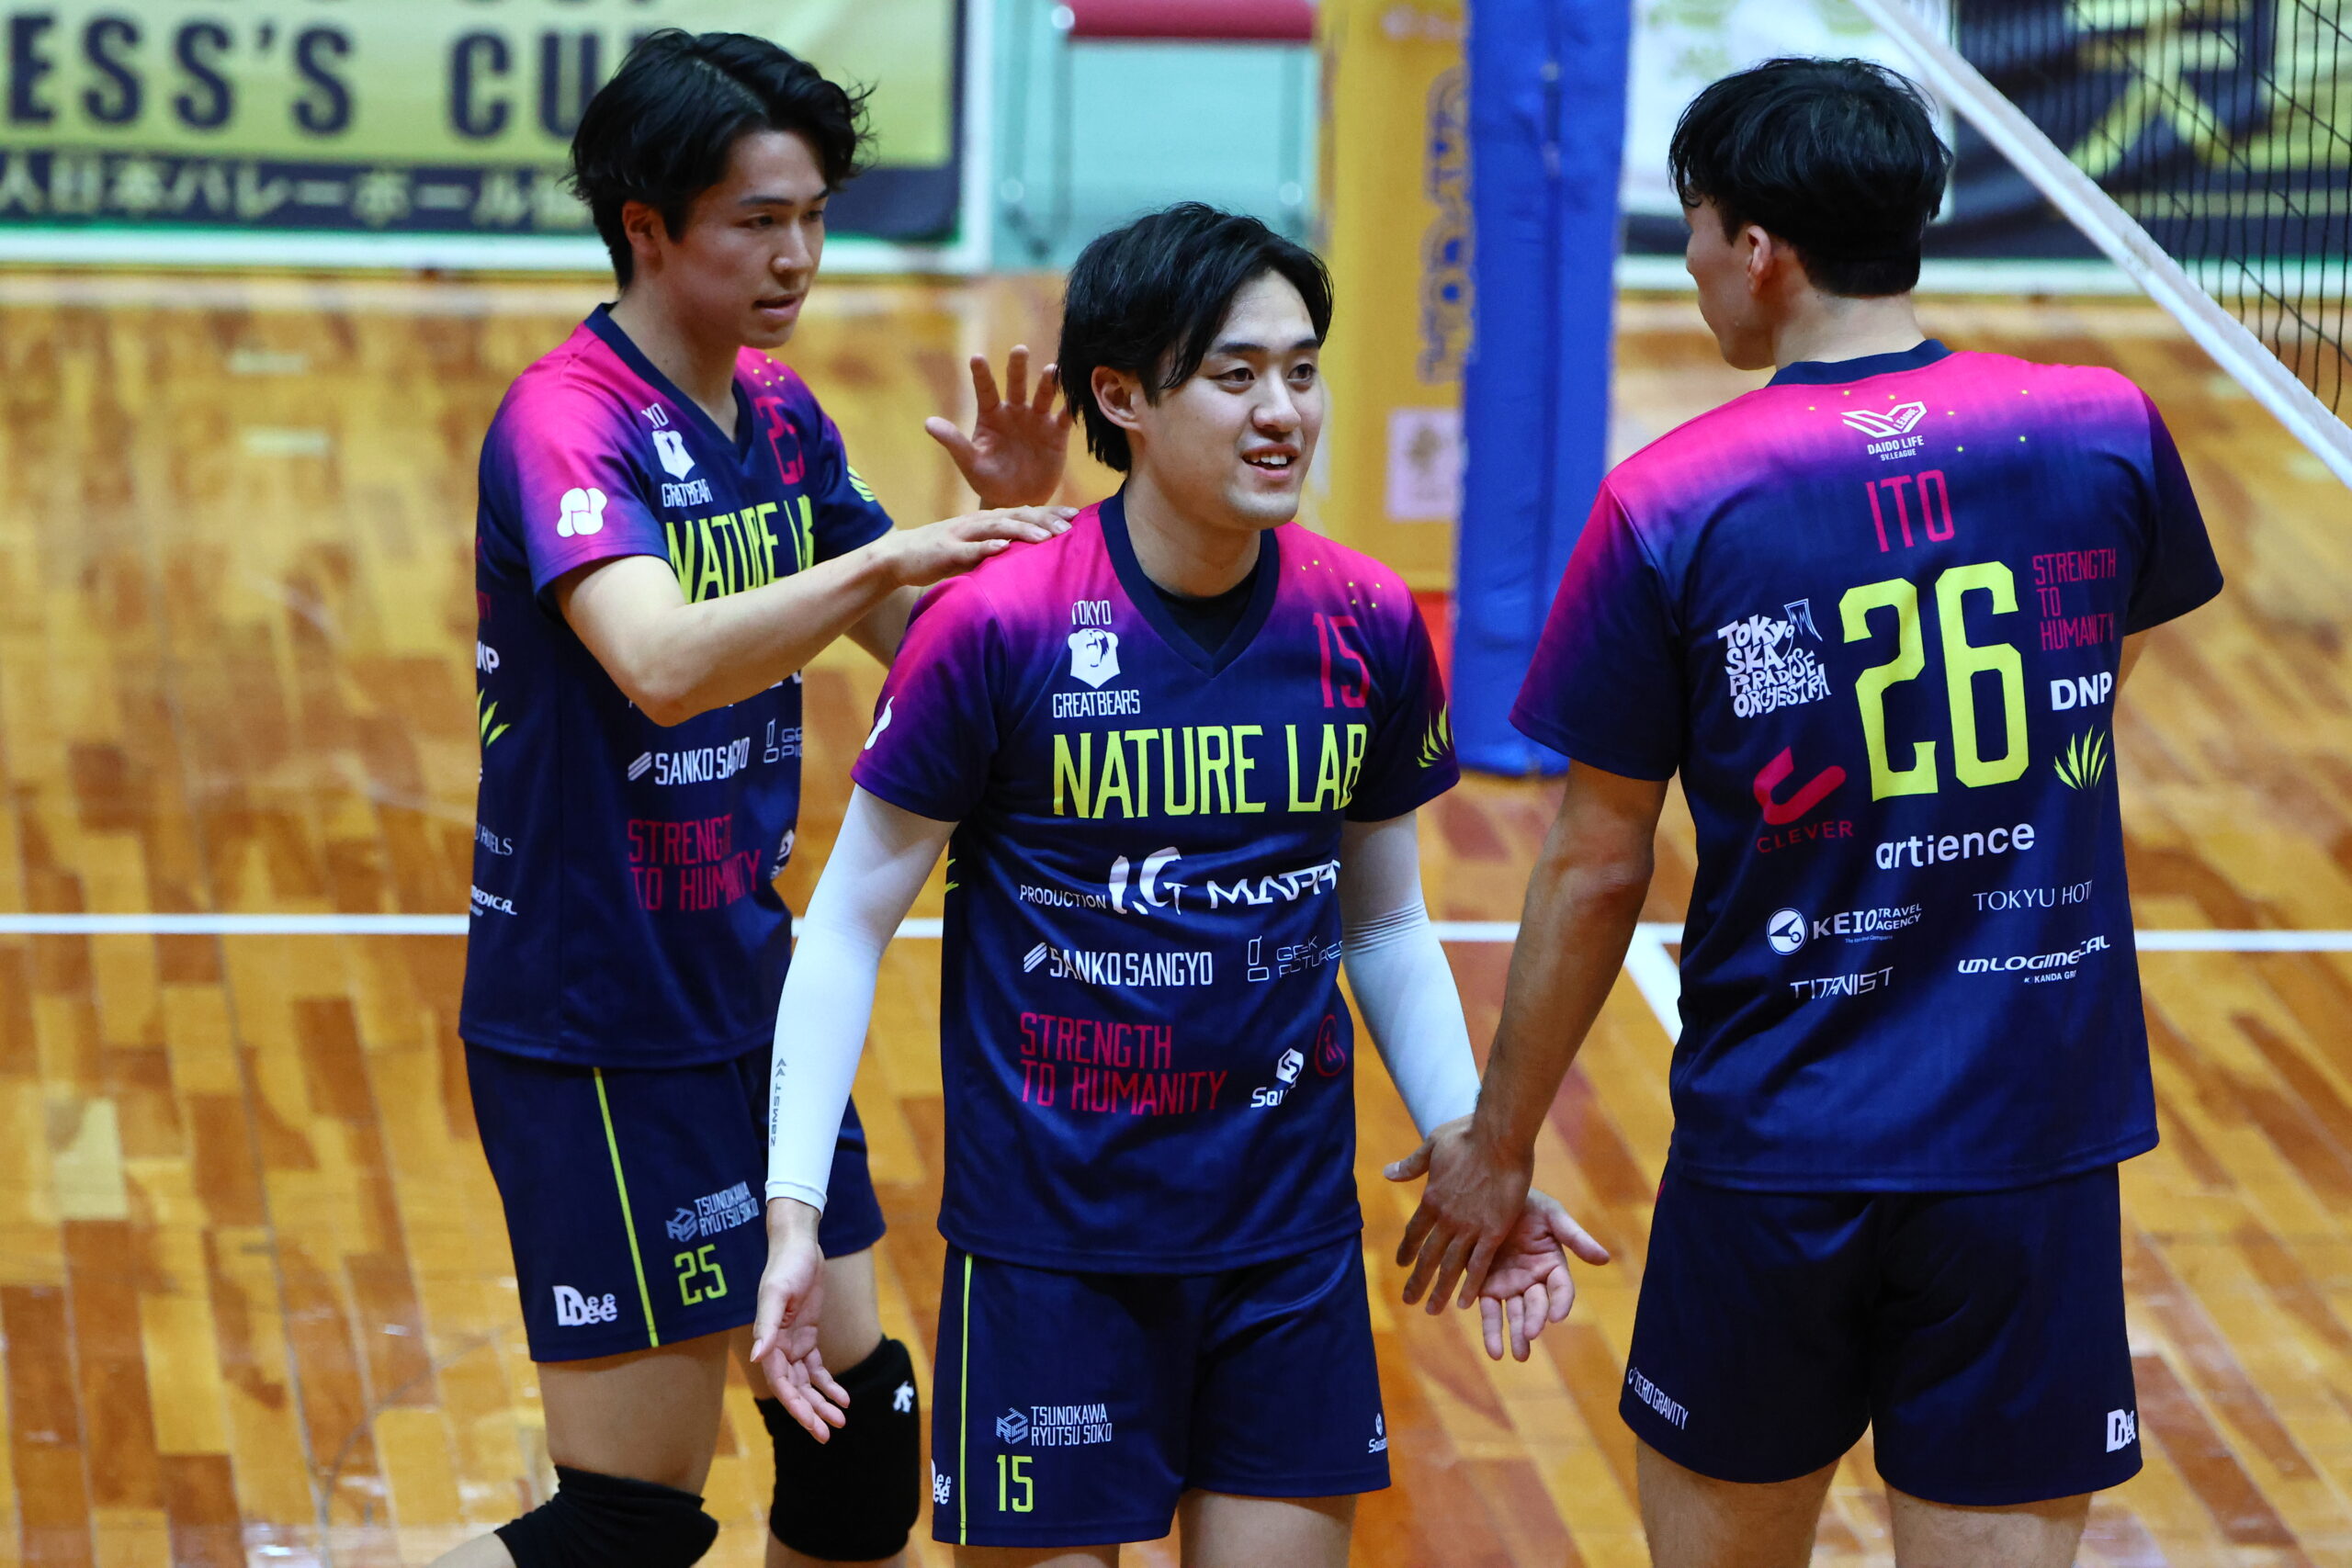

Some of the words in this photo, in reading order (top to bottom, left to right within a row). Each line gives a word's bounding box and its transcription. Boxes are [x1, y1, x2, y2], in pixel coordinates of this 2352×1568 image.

[449, 30, 649, 140] CU
[1867, 439, 1900, 455] DAIDO
[1901, 434, 1925, 449] LIFE
[1865, 468, 1955, 552] ITO
[2032, 548, 2116, 585] STRENGTH
[2036, 586, 2062, 617] TO
[1312, 612, 1371, 708] 15
[1724, 642, 1786, 675] SKA
[1838, 560, 2030, 802] 26
[2051, 671, 2112, 711] DNP
[1053, 689, 1141, 718] GREATBEARS
[654, 748, 714, 785] SANKO
[1053, 724, 1267, 819] NATURE
[1285, 724, 1367, 813] LAB
[1757, 820, 1853, 853] CLEVER
[1875, 823, 2036, 870] artience
[629, 866, 663, 911] TO
[1019, 884, 1107, 909] PRODUCTION
[1973, 888, 2055, 911] TOKYU
[2062, 879, 2093, 906] HOT
[1813, 909, 1877, 940] KEIO
[1875, 913, 1922, 931] AGENCY
[1877, 903, 1923, 919] TRAVEL
[1049, 946, 1121, 986] SANKO
[1125, 951, 1213, 987] SANGYO
[2034, 973, 2063, 984] KANDA
[1019, 1011, 1172, 1069] STRENGTH
[1020, 1058, 1056, 1107] TO
[1071, 1066, 1227, 1116] HUMANITY
[674, 1244, 728, 1306] 25
[1030, 1404, 1108, 1426] TSUNOKAWA
[1652, 1388, 1689, 1430] GRAVITY
[1031, 1425, 1080, 1447] RYUTSU
[1083, 1422, 1113, 1445] SOKO
[996, 1454, 1034, 1513] 15
